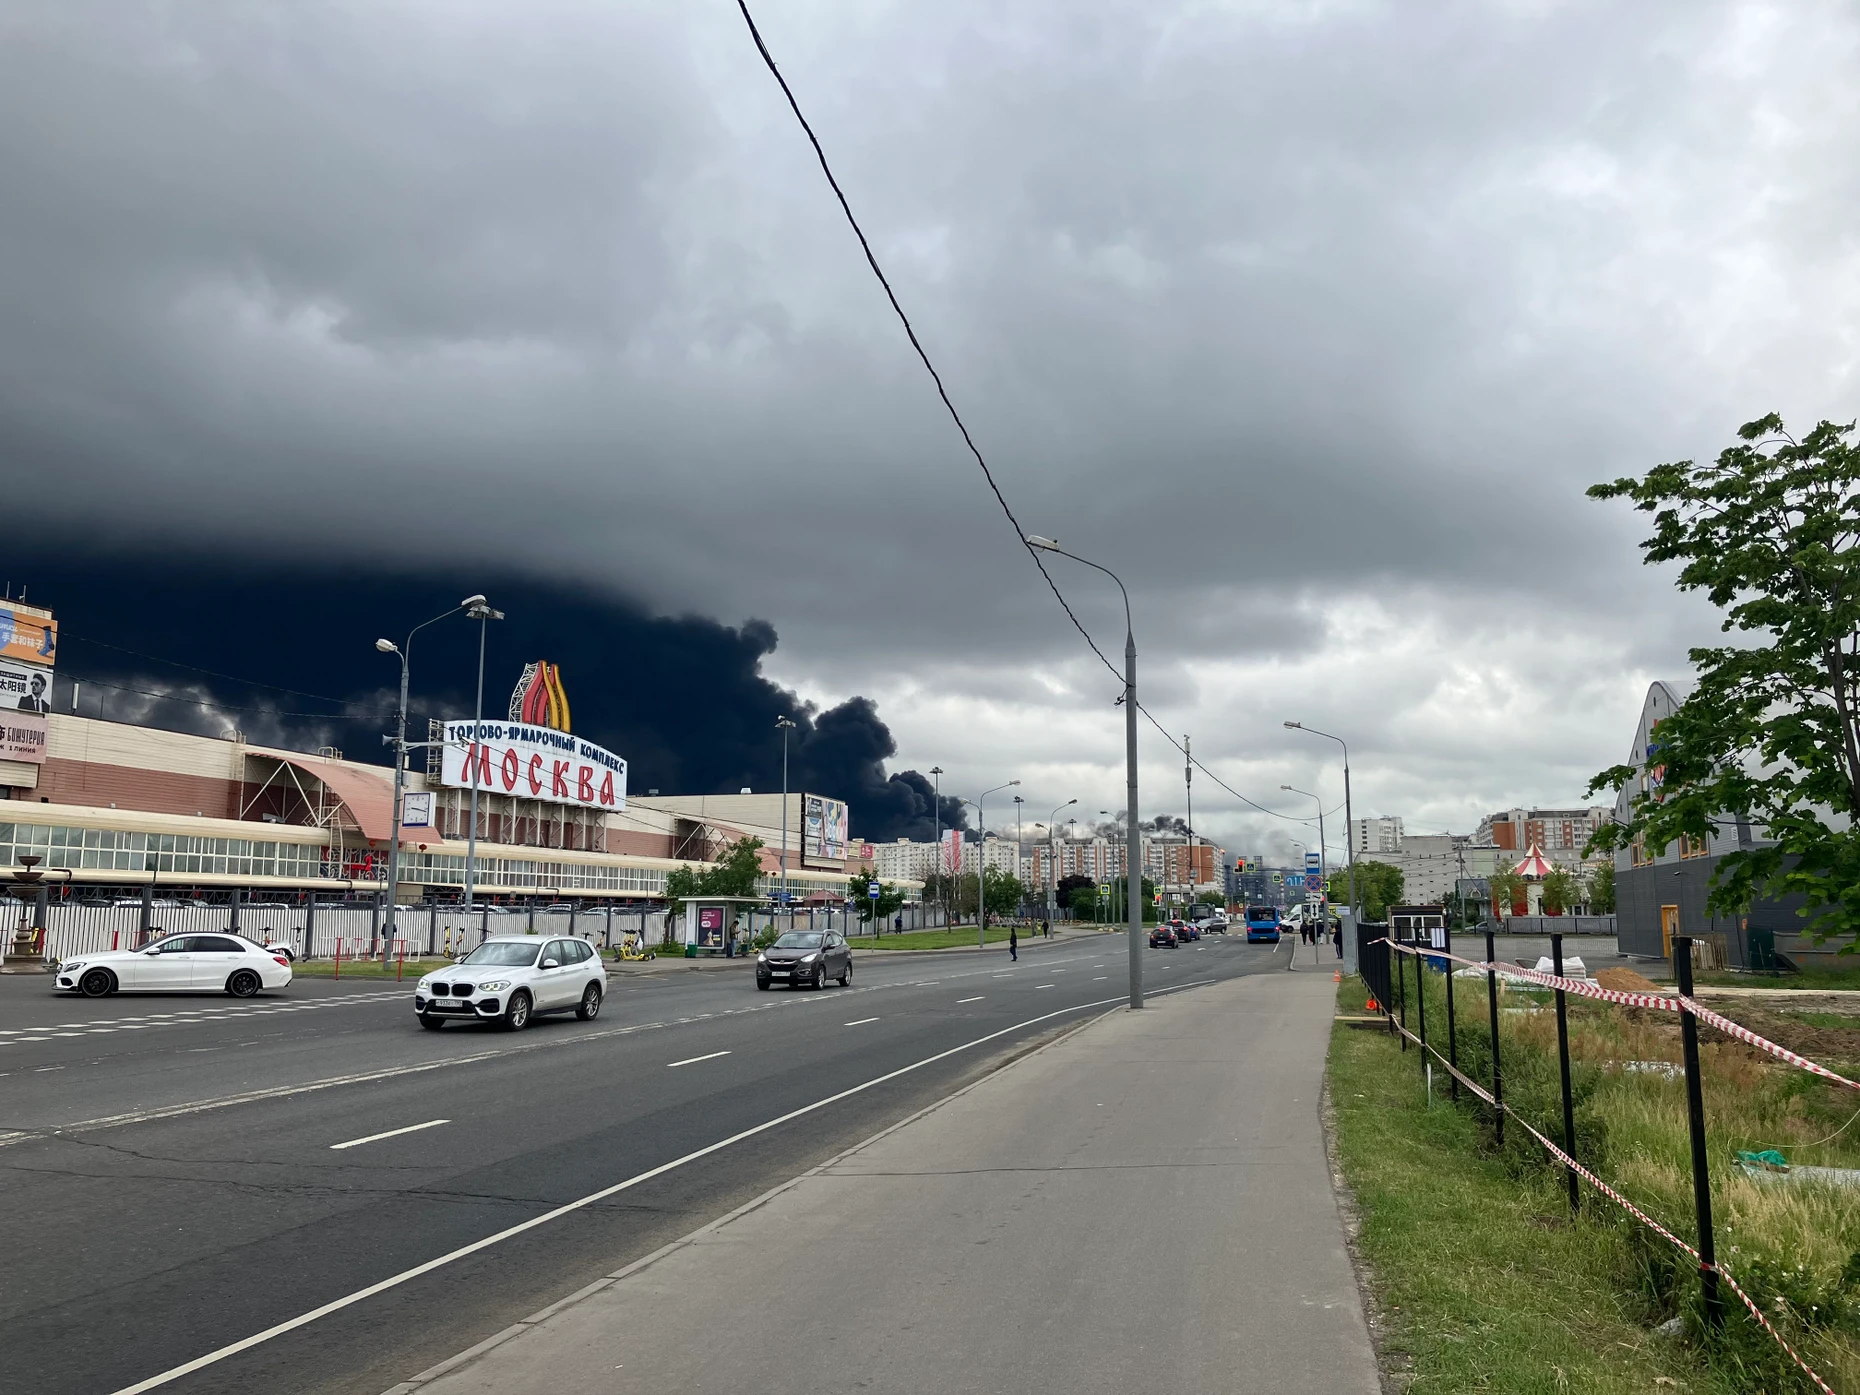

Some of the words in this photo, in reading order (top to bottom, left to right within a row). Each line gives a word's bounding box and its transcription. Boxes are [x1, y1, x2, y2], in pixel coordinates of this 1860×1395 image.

[14, 745, 36, 754] ЛИНИЯ
[580, 743, 625, 774] КОМПЛЕКС
[461, 743, 615, 805] МОСКВА
